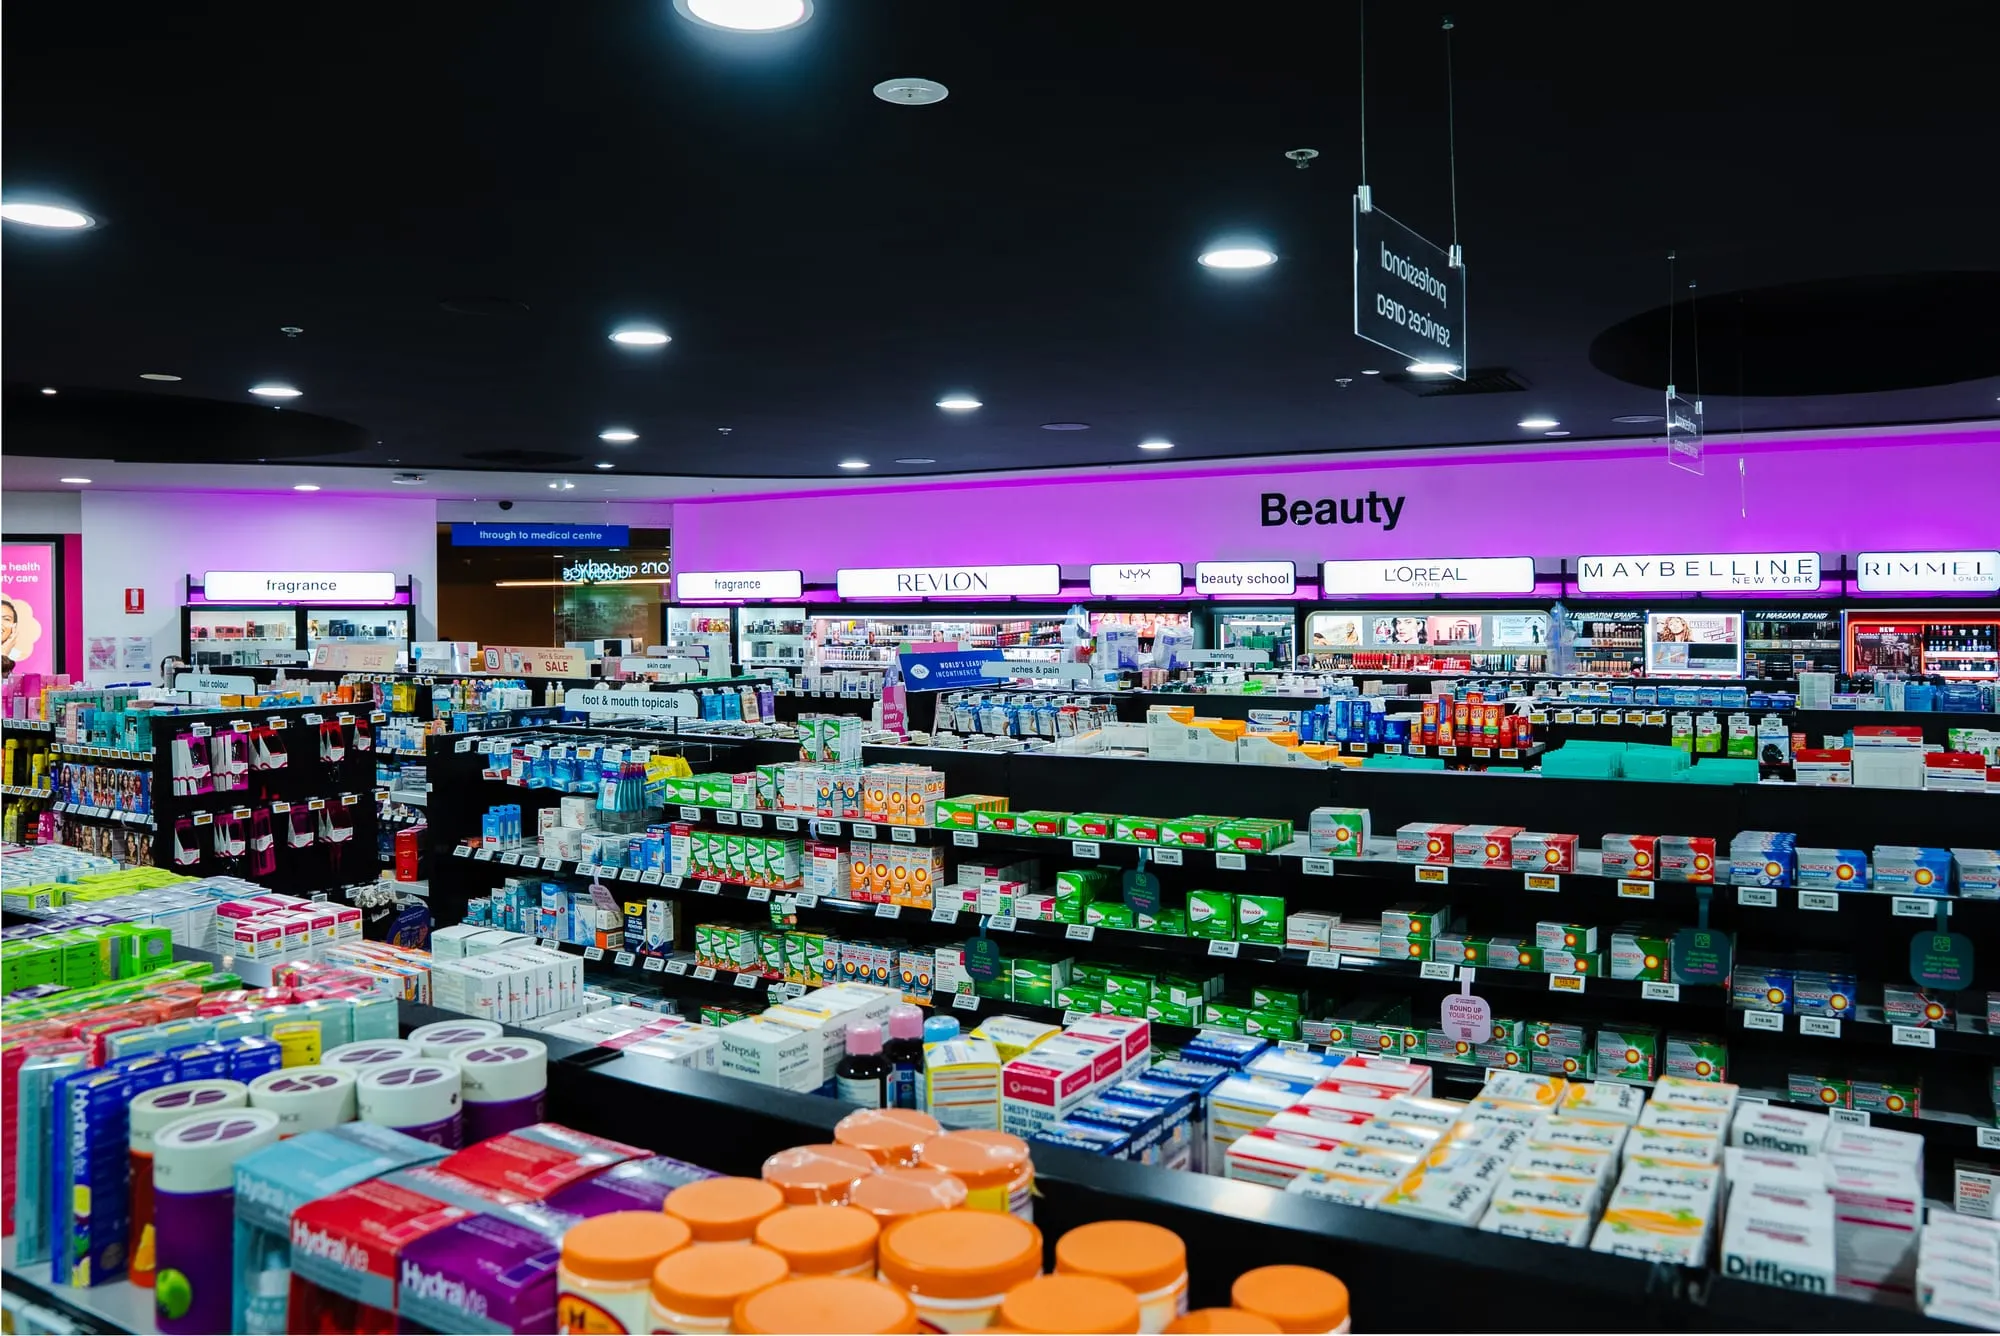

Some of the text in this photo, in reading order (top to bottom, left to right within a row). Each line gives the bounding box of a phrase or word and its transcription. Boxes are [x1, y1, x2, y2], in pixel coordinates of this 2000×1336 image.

[1260, 491, 1406, 531] Beauty
[479, 530, 603, 541] through to medical centre
[9, 562, 41, 571] health
[1583, 559, 1814, 578] MAYBELLINE
[1864, 561, 1993, 576] RIMMEL
[16, 574, 39, 583] care
[266, 578, 337, 594] fragrance
[714, 577, 761, 592] fragrance
[897, 571, 989, 592] REVLON
[1200, 571, 1290, 587] beauty school
[1732, 575, 1813, 585] NEW YORK
[1802, 612, 1828, 620] BRAND
[363, 655, 383, 667] SALE
[1210, 651, 1235, 660] tanning
[545, 661, 569, 672] SALE
[647, 662, 657, 670] skin
[935, 668, 977, 678] INCONTINENCE
[1011, 665, 1060, 675] aches & pain
[199, 679, 229, 689] hair colour
[582, 693, 679, 710] foot & mouth topicals
[1448, 1012, 1484, 1021] YOUR SHOP
[1450, 1004, 1482, 1014] ROUND UP
[721, 1039, 761, 1061] Strepsils
[778, 1042, 809, 1061] Strepsils
[722, 1060, 734, 1069] DRY
[1003, 1103, 1029, 1115] CHESTY
[1030, 1108, 1056, 1121] COUGH
[1004, 1114, 1042, 1130] LIQUID FOR
[71, 1088, 90, 1176] Hydralyte
[1742, 1130, 1809, 1156] Difflam
[291, 1218, 370, 1273] Hydralyte
[1725, 1252, 1826, 1293] Difflam
[402, 1260, 489, 1319] Hydralyte
